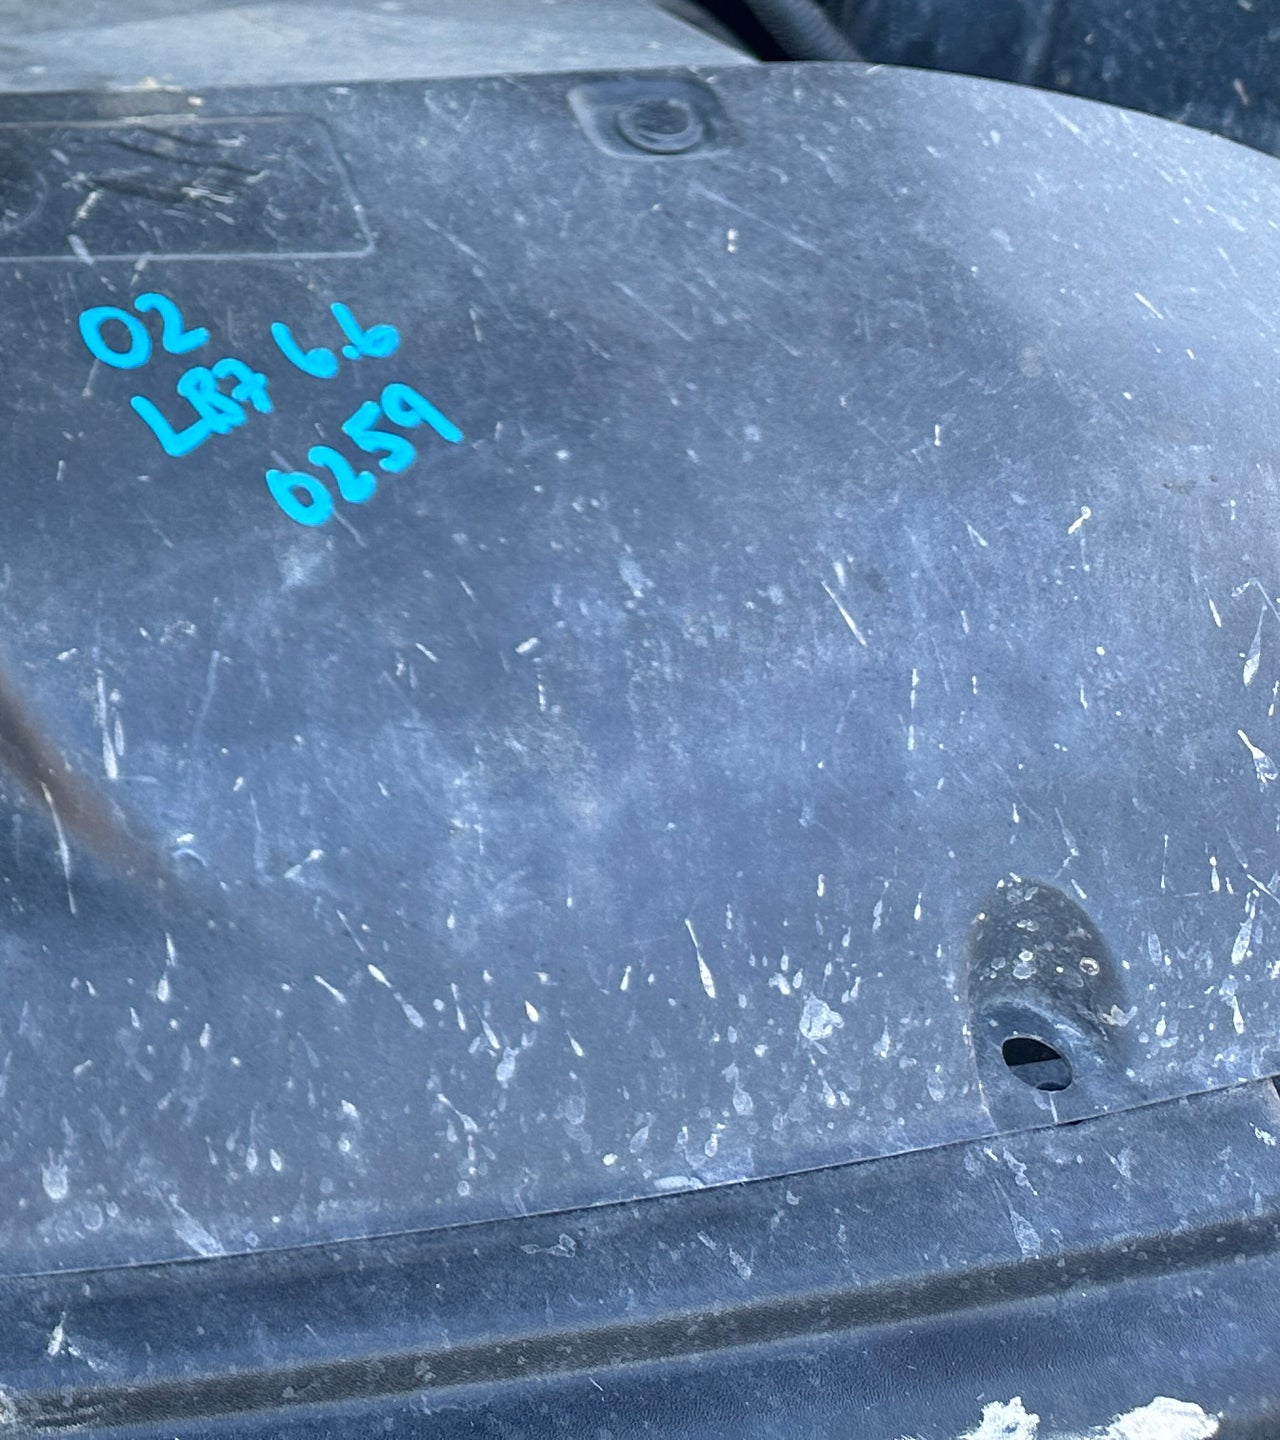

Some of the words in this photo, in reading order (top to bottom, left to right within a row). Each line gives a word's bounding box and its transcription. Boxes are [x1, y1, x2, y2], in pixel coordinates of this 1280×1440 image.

[77, 291, 211, 370] 02
[270, 301, 401, 380] 6.6
[264, 381, 465, 527] 0259
